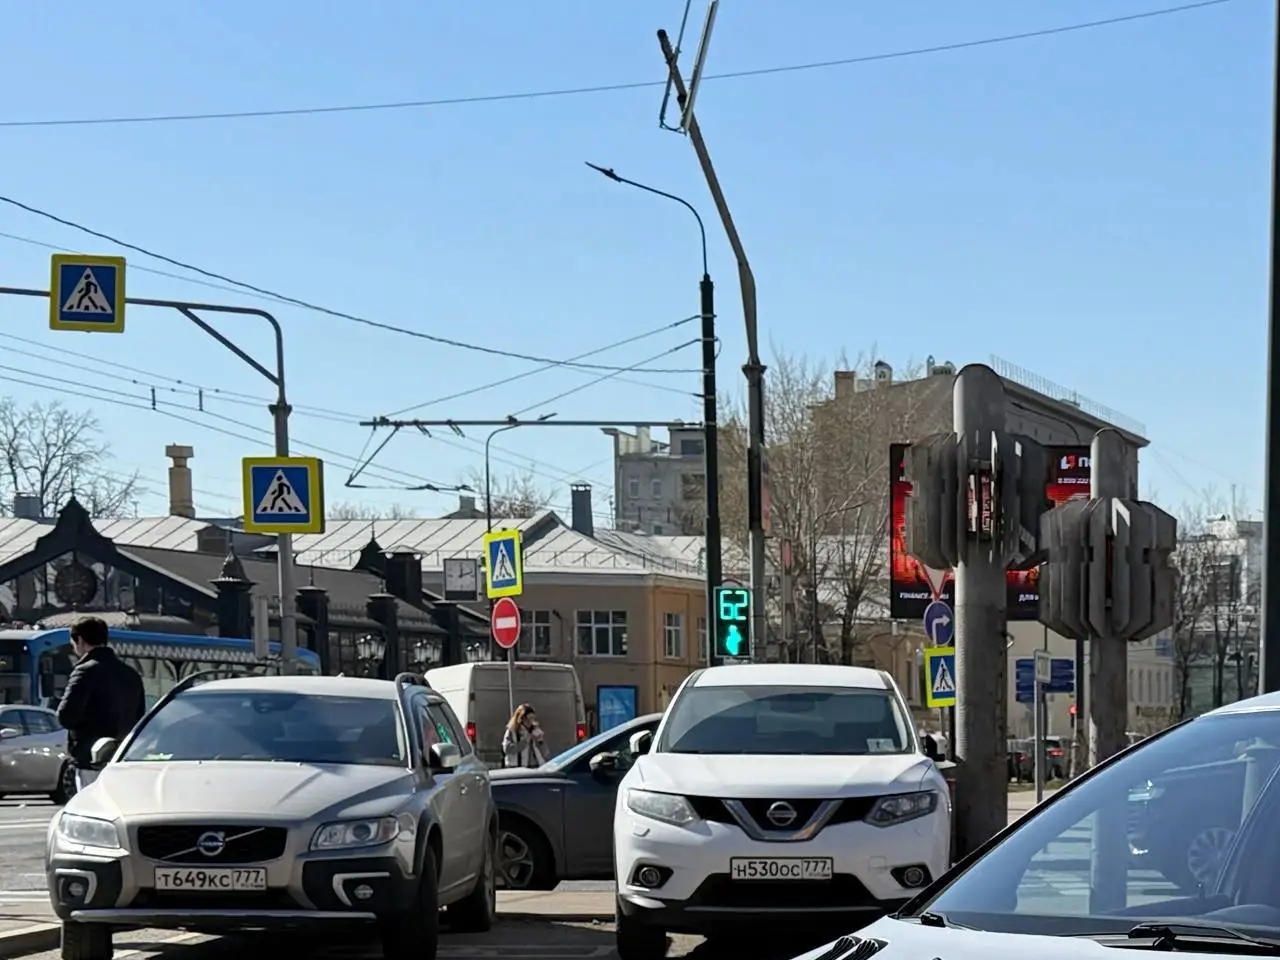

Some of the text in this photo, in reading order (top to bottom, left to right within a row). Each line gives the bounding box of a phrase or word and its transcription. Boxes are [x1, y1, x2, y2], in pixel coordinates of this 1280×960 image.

[720, 590, 748, 620] 62
[803, 860, 827, 872] 777
[234, 870, 261, 883] 777
